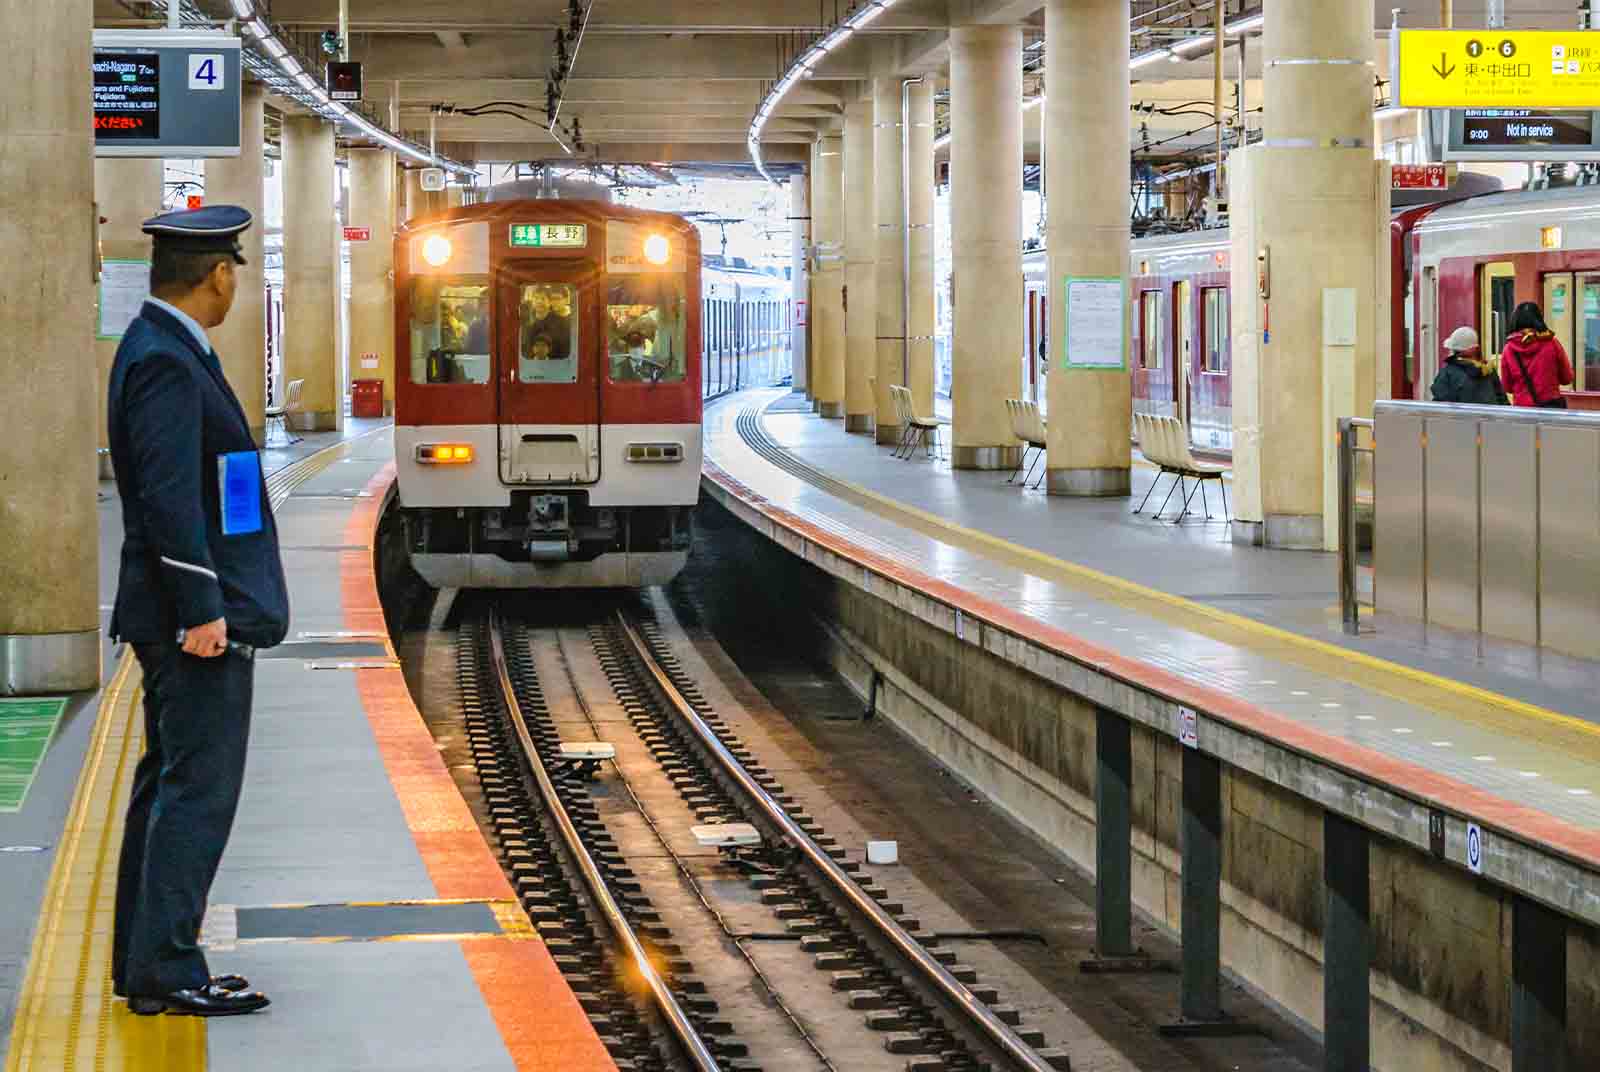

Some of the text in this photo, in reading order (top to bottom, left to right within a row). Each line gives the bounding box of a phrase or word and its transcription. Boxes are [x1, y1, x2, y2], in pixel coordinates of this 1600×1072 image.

[195, 58, 217, 84] 4
[1470, 129, 1488, 139] 9:00
[1506, 123, 1553, 137] Not in service
[1427, 167, 1443, 175] SOS
[545, 226, 579, 240] 長野
